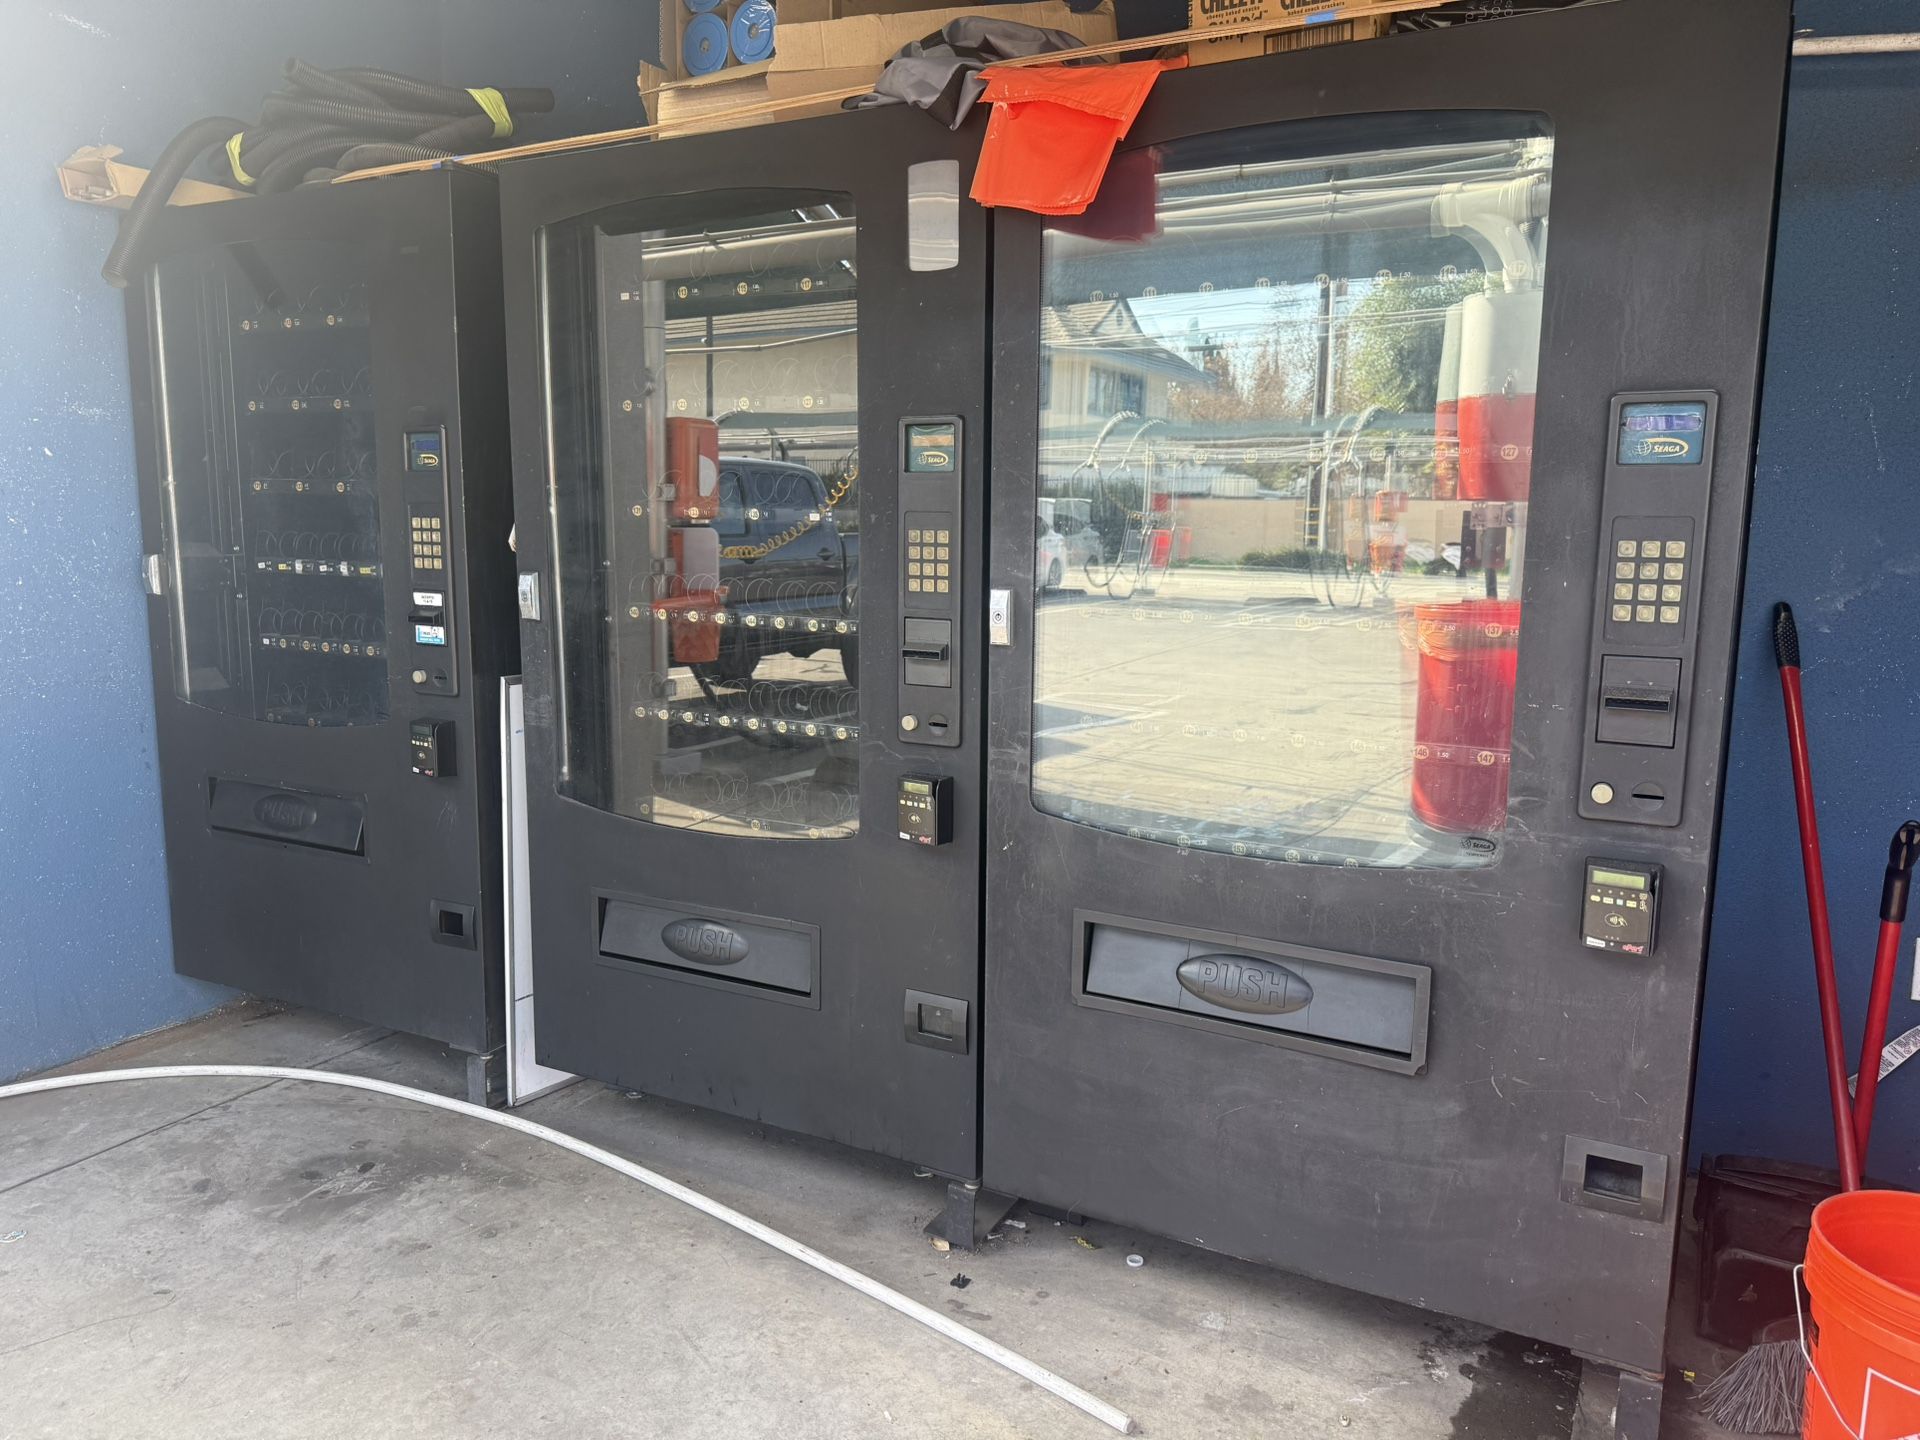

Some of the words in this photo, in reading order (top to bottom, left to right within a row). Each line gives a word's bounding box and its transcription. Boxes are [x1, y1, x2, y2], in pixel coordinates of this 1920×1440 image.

[1287, 8, 1303, 16] baked
[1304, 5, 1320, 13] snack
[1502, 447, 1517, 457] 127
[1652, 444, 1680, 453] SEAGA
[1487, 625, 1500, 635] 137
[1414, 748, 1427, 757] 146
[1478, 754, 1493, 763] 147
[672, 923, 734, 960] PUSH
[1198, 959, 1289, 1008] PUSH
